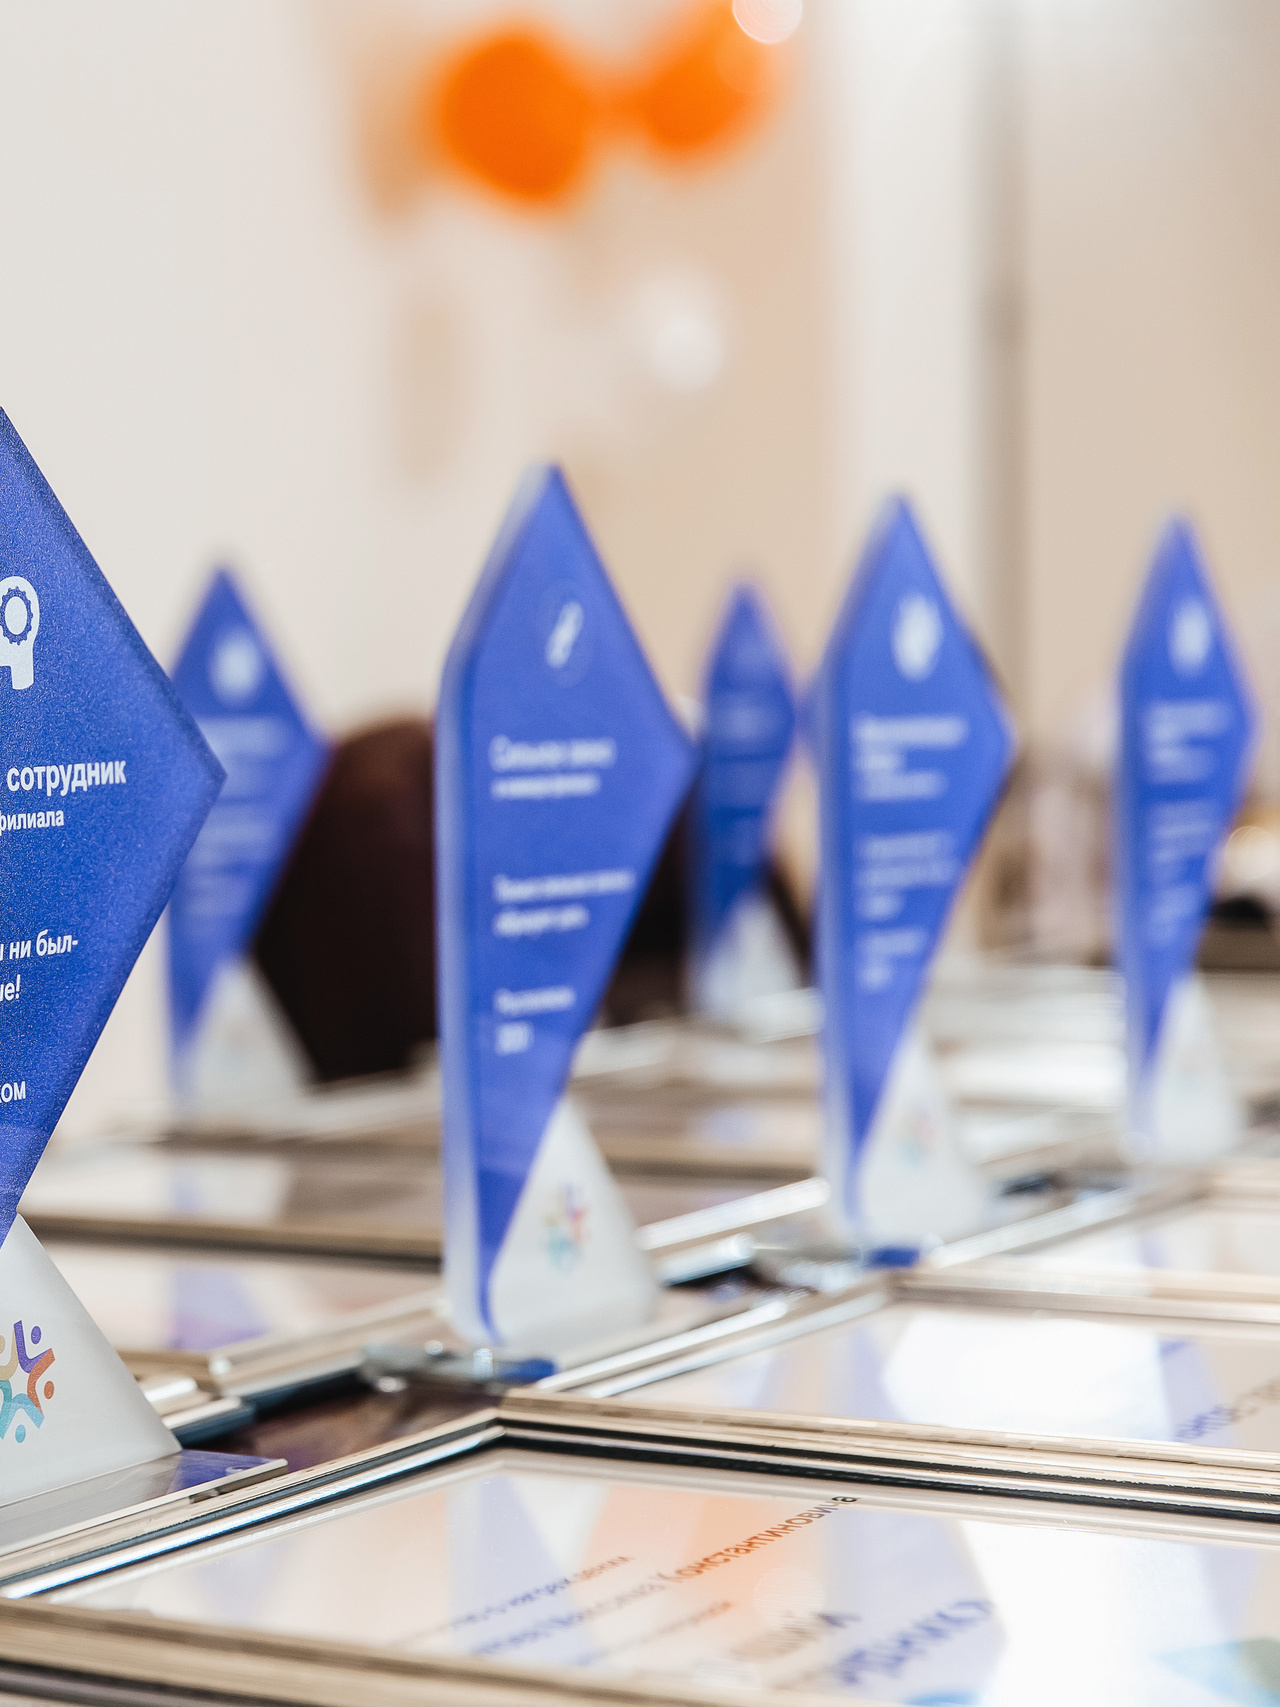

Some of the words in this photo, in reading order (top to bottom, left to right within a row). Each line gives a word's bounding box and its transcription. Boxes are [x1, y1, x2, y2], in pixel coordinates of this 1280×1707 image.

[7, 759, 127, 796] сотрудник
[9, 937, 31, 960] ни
[36, 928, 78, 957] был-
